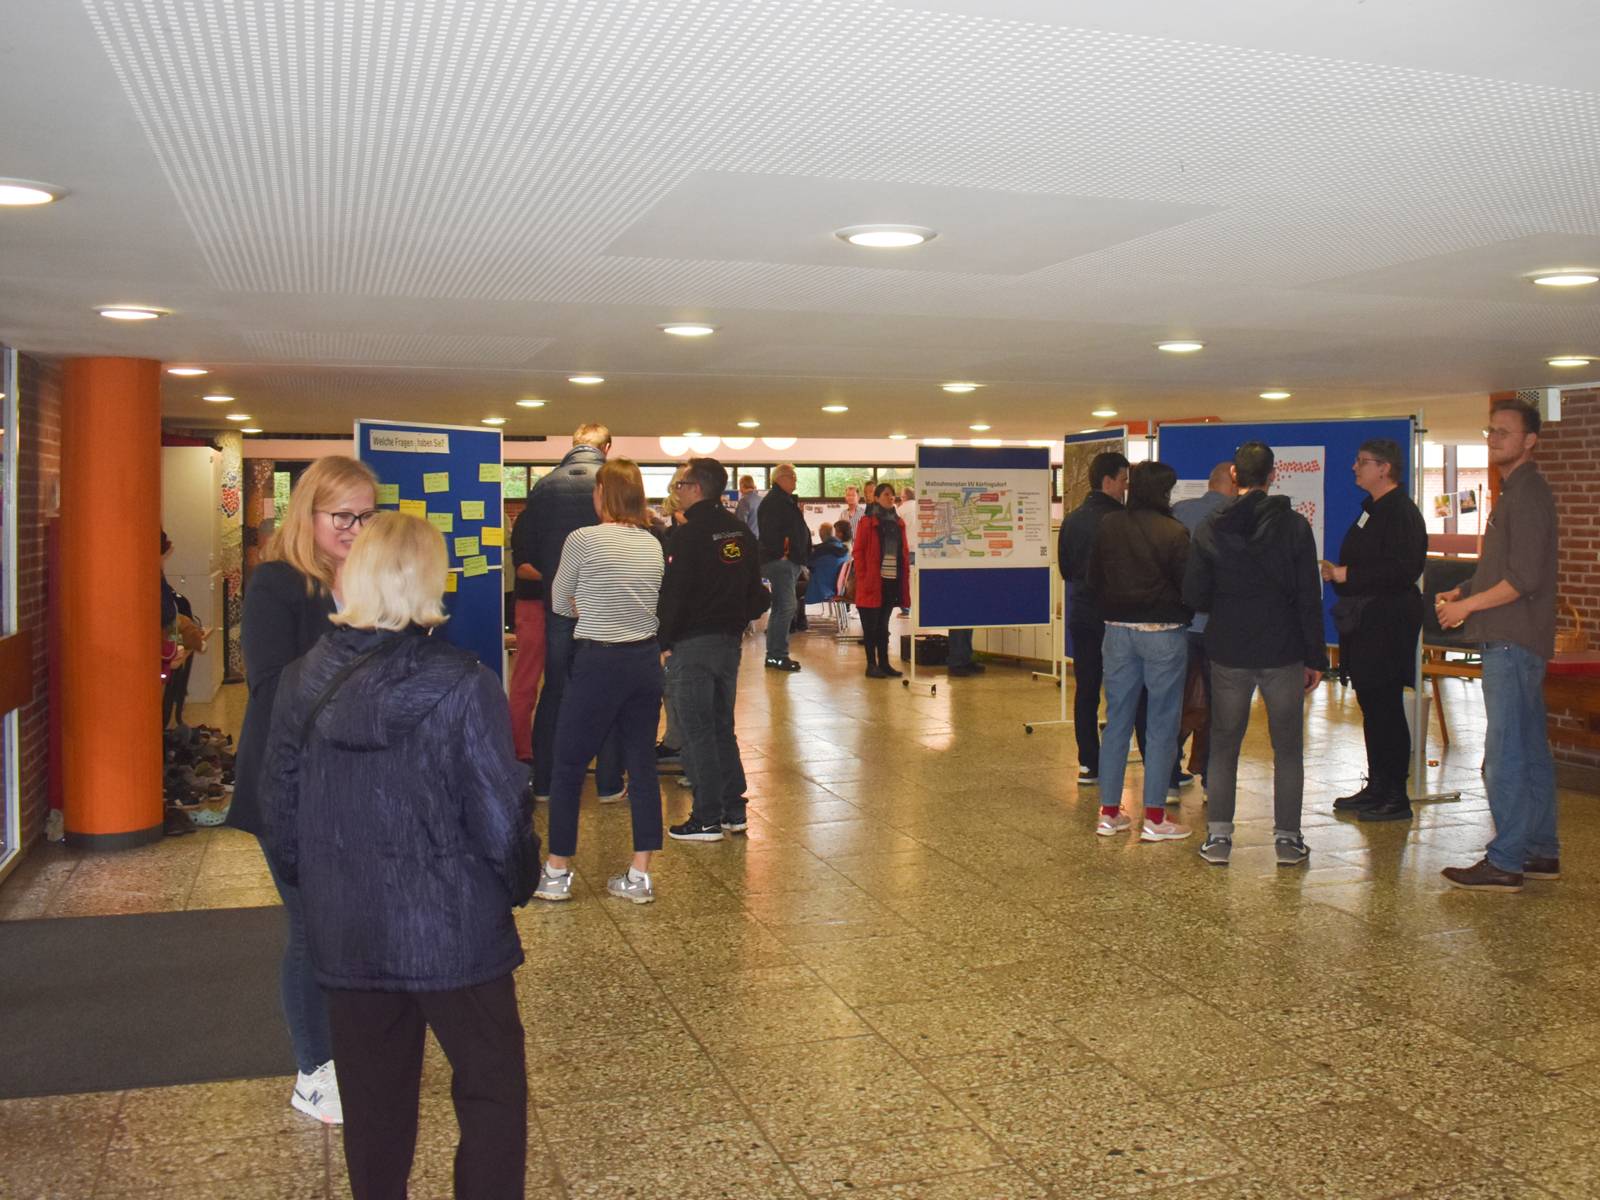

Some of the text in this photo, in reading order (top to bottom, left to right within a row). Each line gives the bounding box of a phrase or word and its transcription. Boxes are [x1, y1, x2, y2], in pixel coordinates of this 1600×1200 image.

[373, 436, 394, 448] Welche
[394, 437, 414, 449] Fragen
[925, 480, 967, 488] Maßnahmenplan
